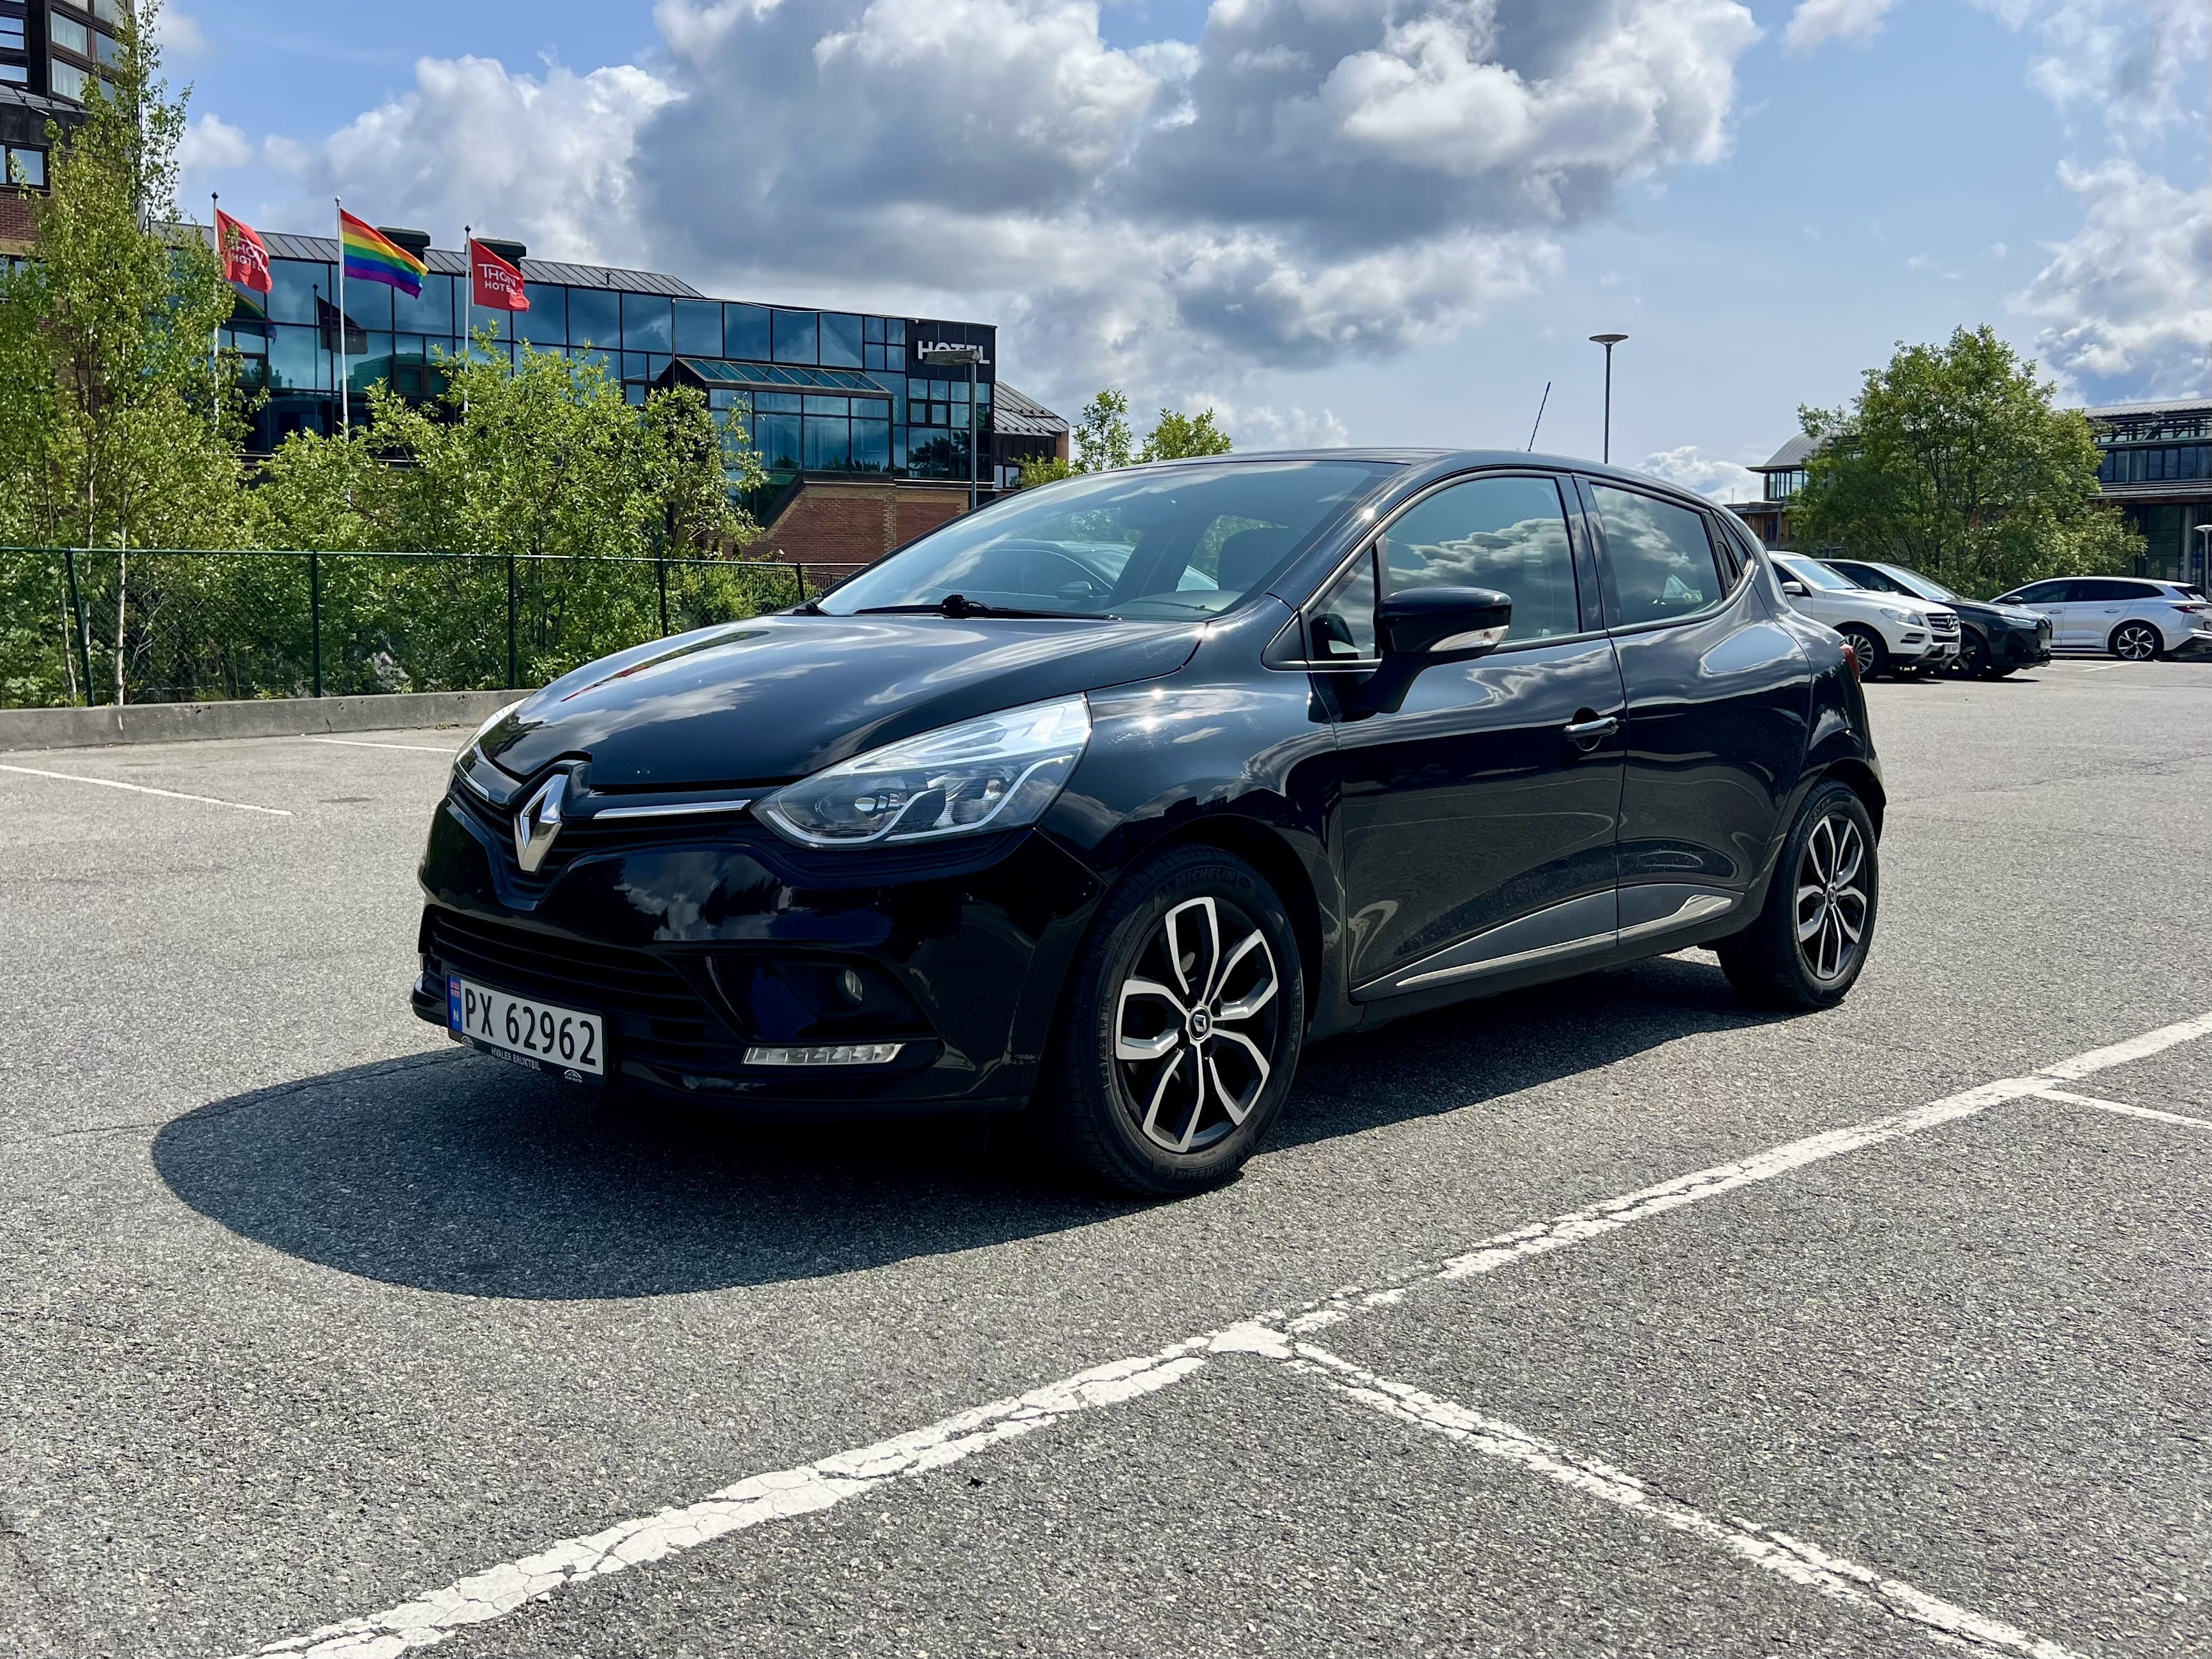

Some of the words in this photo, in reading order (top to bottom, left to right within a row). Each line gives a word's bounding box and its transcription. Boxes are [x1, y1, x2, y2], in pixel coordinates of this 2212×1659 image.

[477, 263, 520, 287] THON
[918, 340, 990, 364] HTL
[1175, 867, 1237, 889] MICHELIN
[453, 1010, 459, 1022] N
[465, 987, 494, 1037] PX
[506, 1003, 596, 1067] 62962
[491, 1046, 512, 1061] HVALER
[513, 1053, 541, 1071] BRUKTBIL
[1174, 1153, 1237, 1180] MICHELIN
